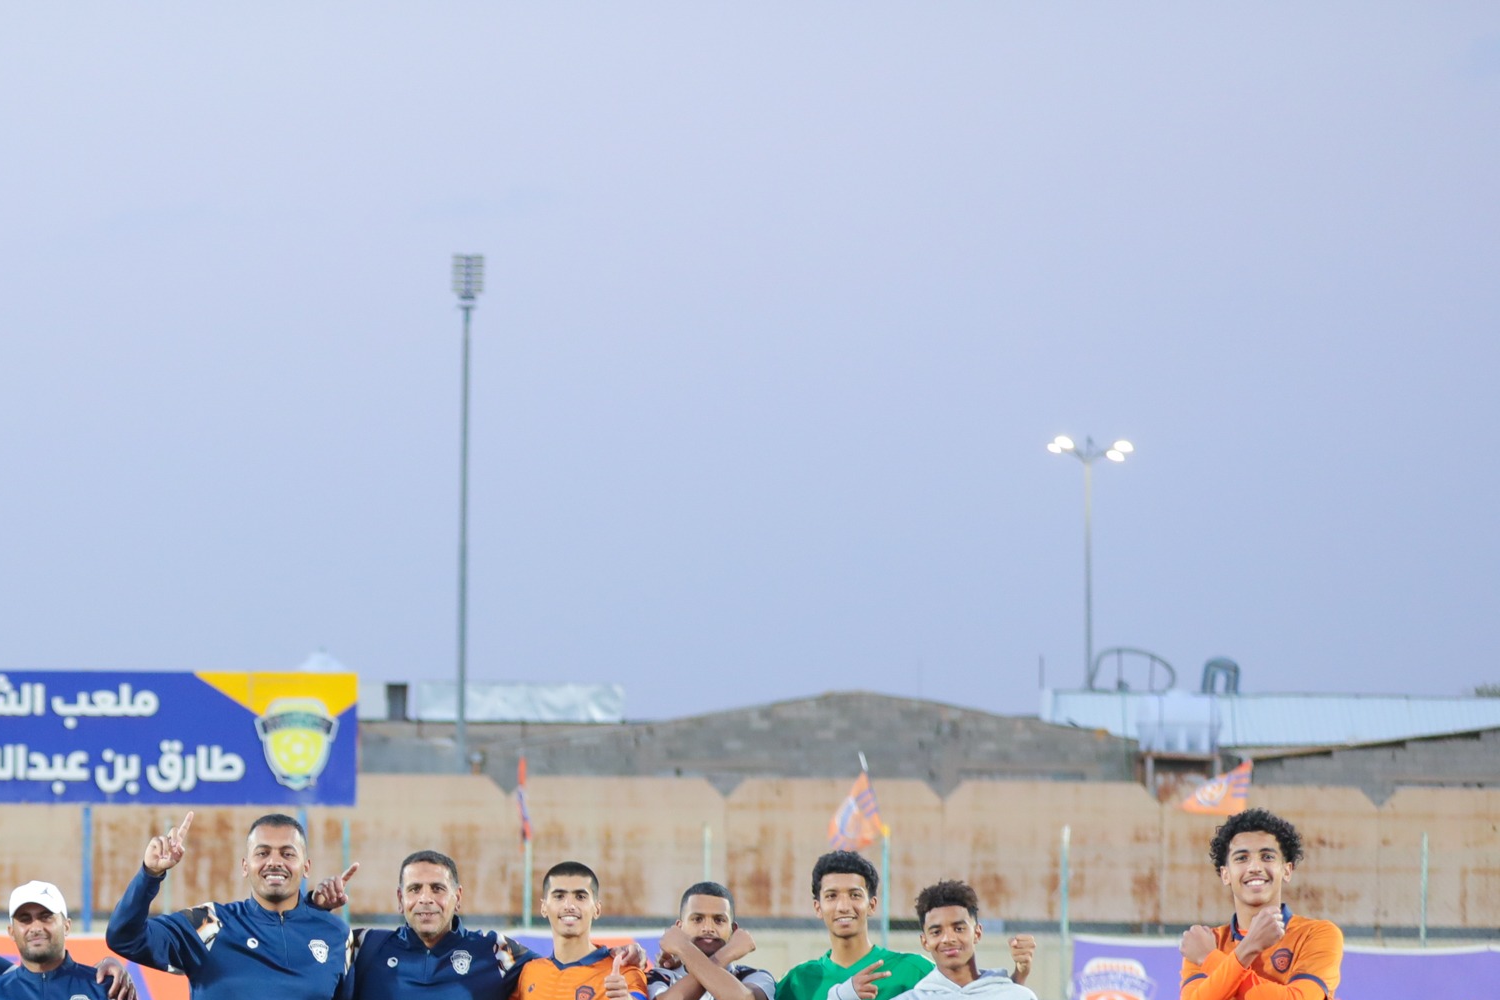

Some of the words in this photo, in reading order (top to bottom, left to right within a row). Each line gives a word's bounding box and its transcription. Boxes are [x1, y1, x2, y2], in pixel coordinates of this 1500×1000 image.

[51, 683, 159, 729] ملعب
[95, 748, 141, 795] بن
[146, 739, 245, 792] طارق
